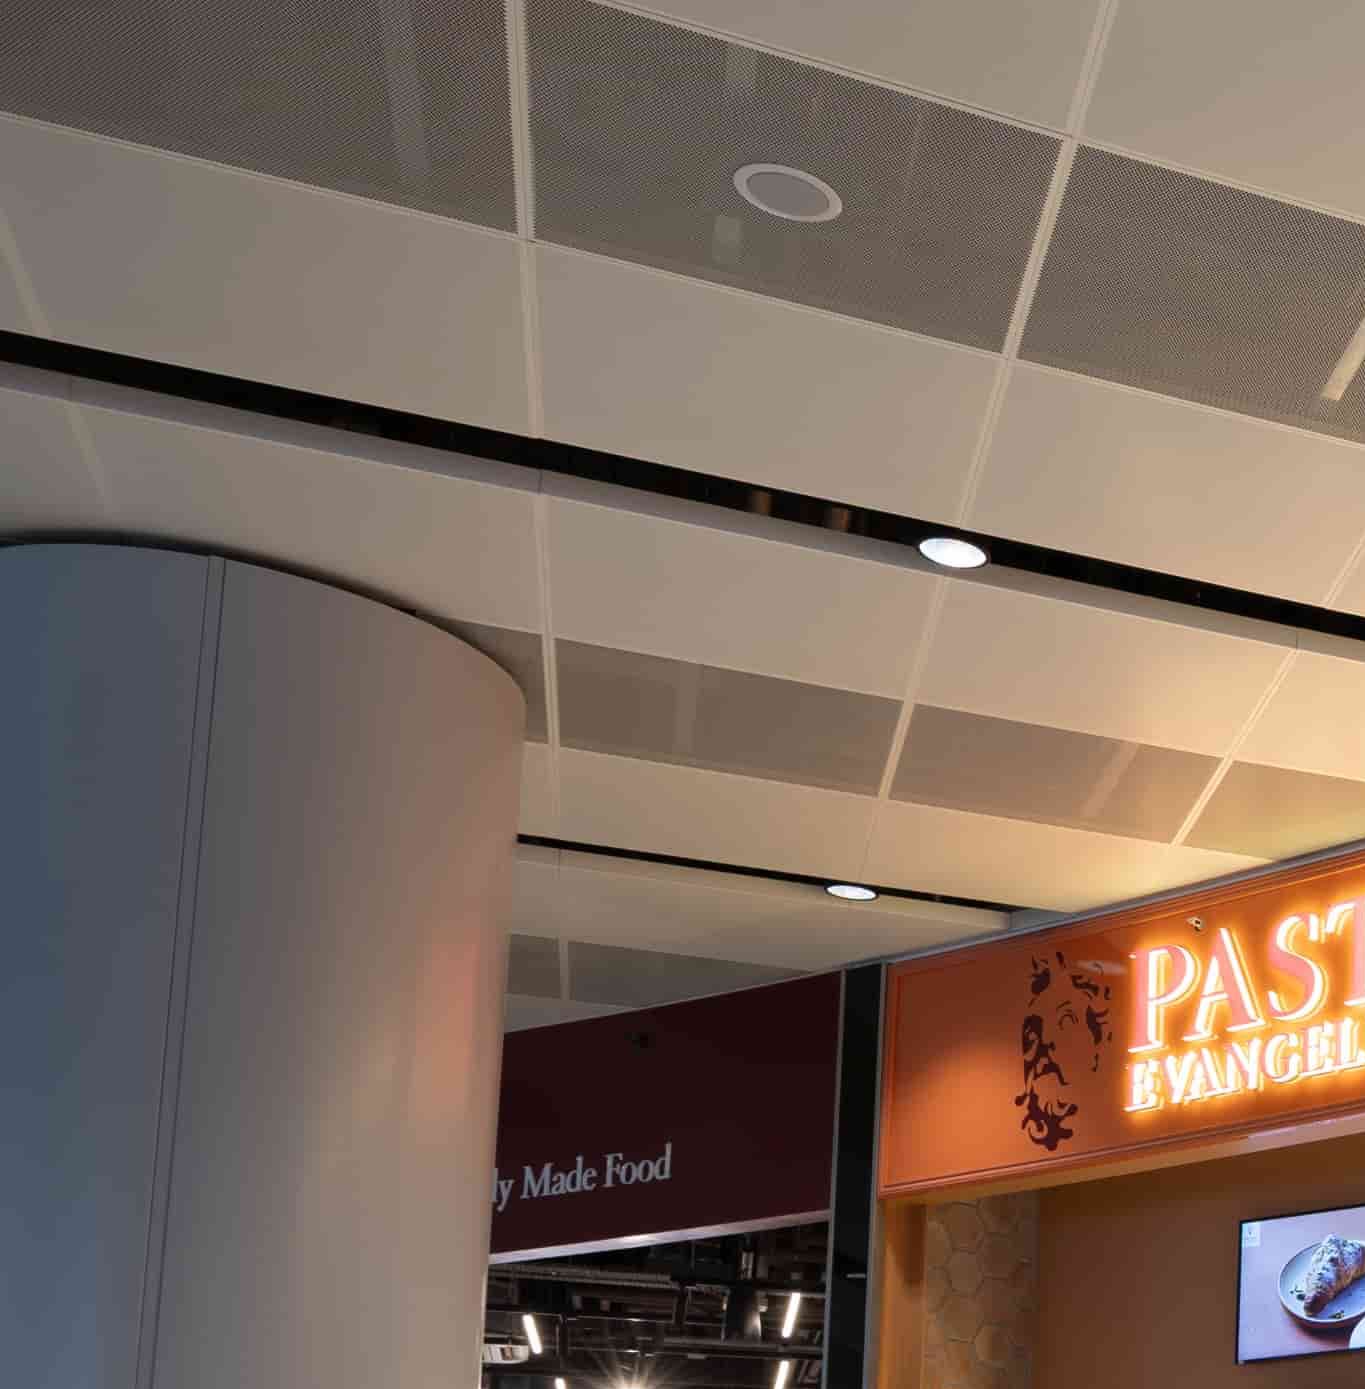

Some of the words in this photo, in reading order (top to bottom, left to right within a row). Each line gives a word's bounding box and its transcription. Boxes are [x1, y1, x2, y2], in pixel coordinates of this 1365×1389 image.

[491, 1167, 514, 1212] ly
[520, 1155, 598, 1200] Made
[602, 1142, 672, 1187] Food
